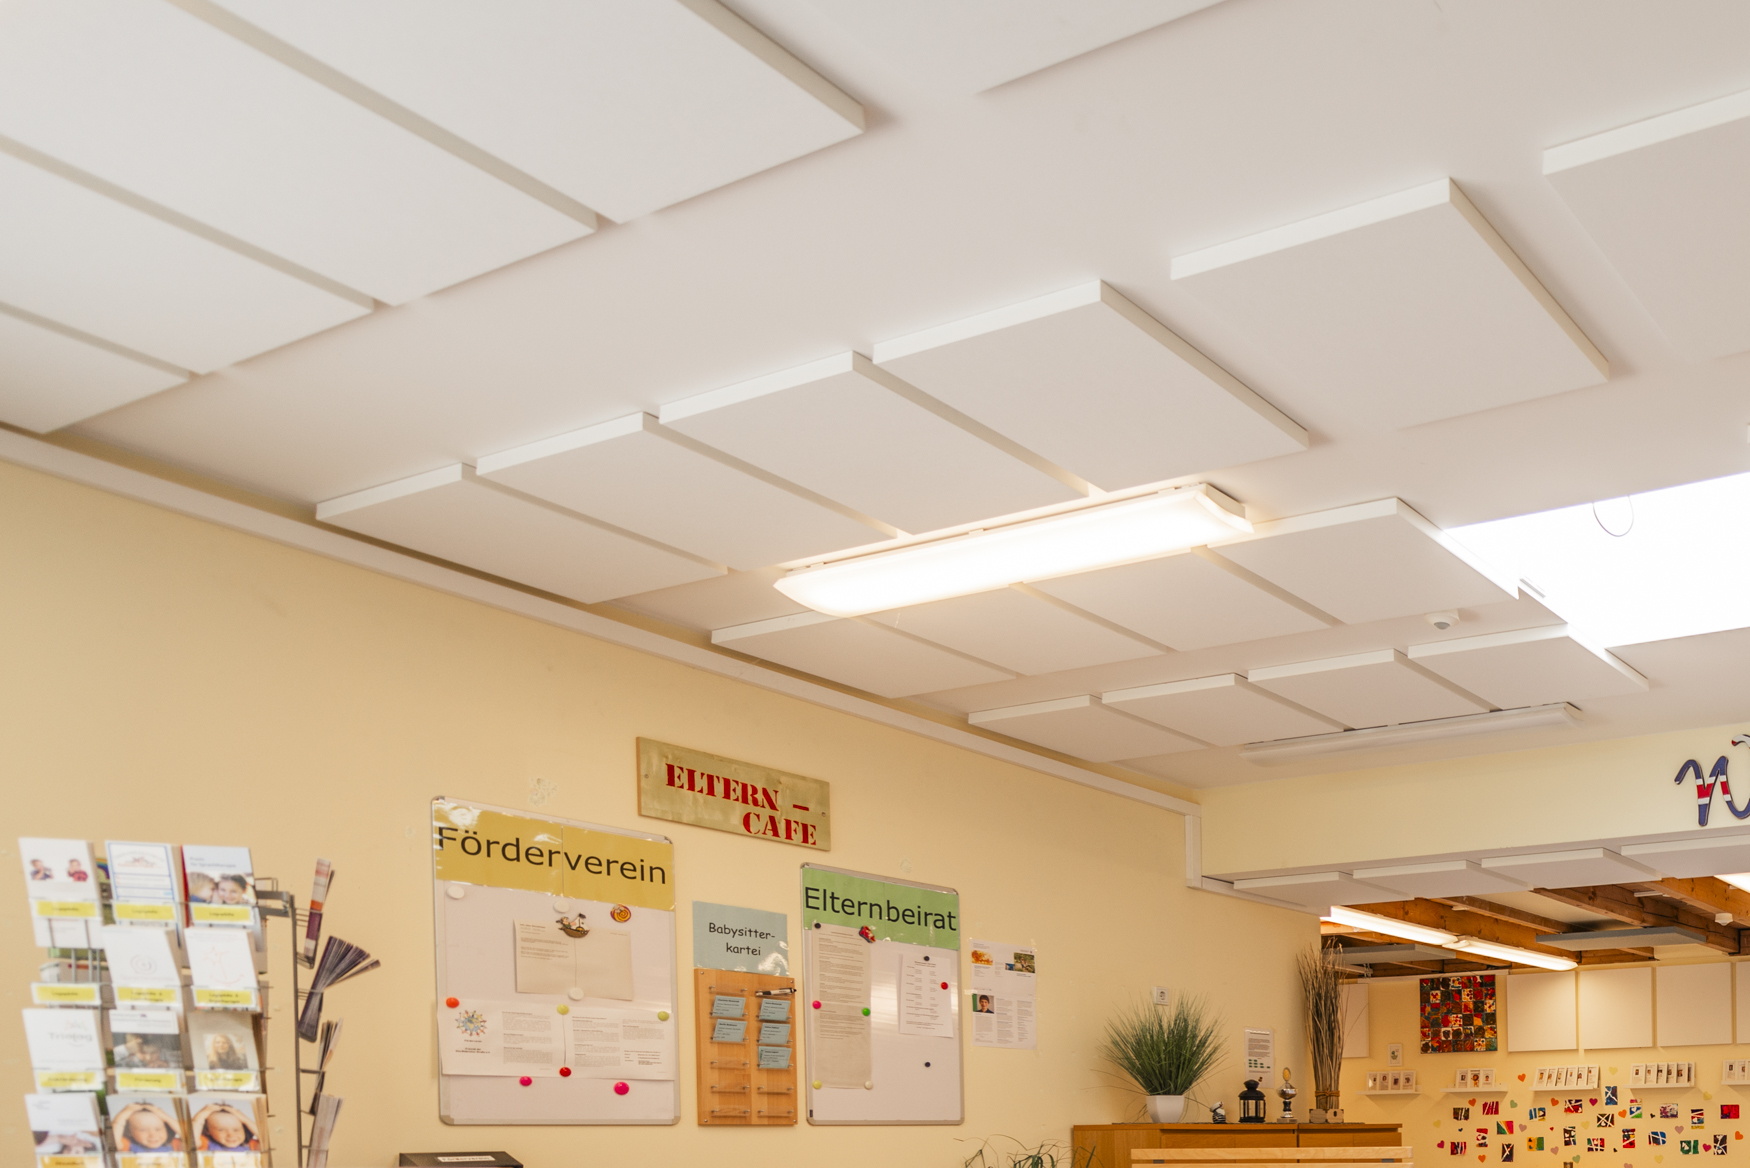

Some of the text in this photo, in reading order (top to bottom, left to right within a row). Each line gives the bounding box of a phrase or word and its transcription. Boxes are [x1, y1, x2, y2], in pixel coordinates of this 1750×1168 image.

[665, 762, 780, 812] ELTERN
[742, 811, 817, 846] CAFE
[437, 826, 667, 885] Förderverein
[804, 886, 957, 932] Elternbeirat
[708, 922, 776, 940] Babysitter-
[726, 942, 761, 956] kartei
